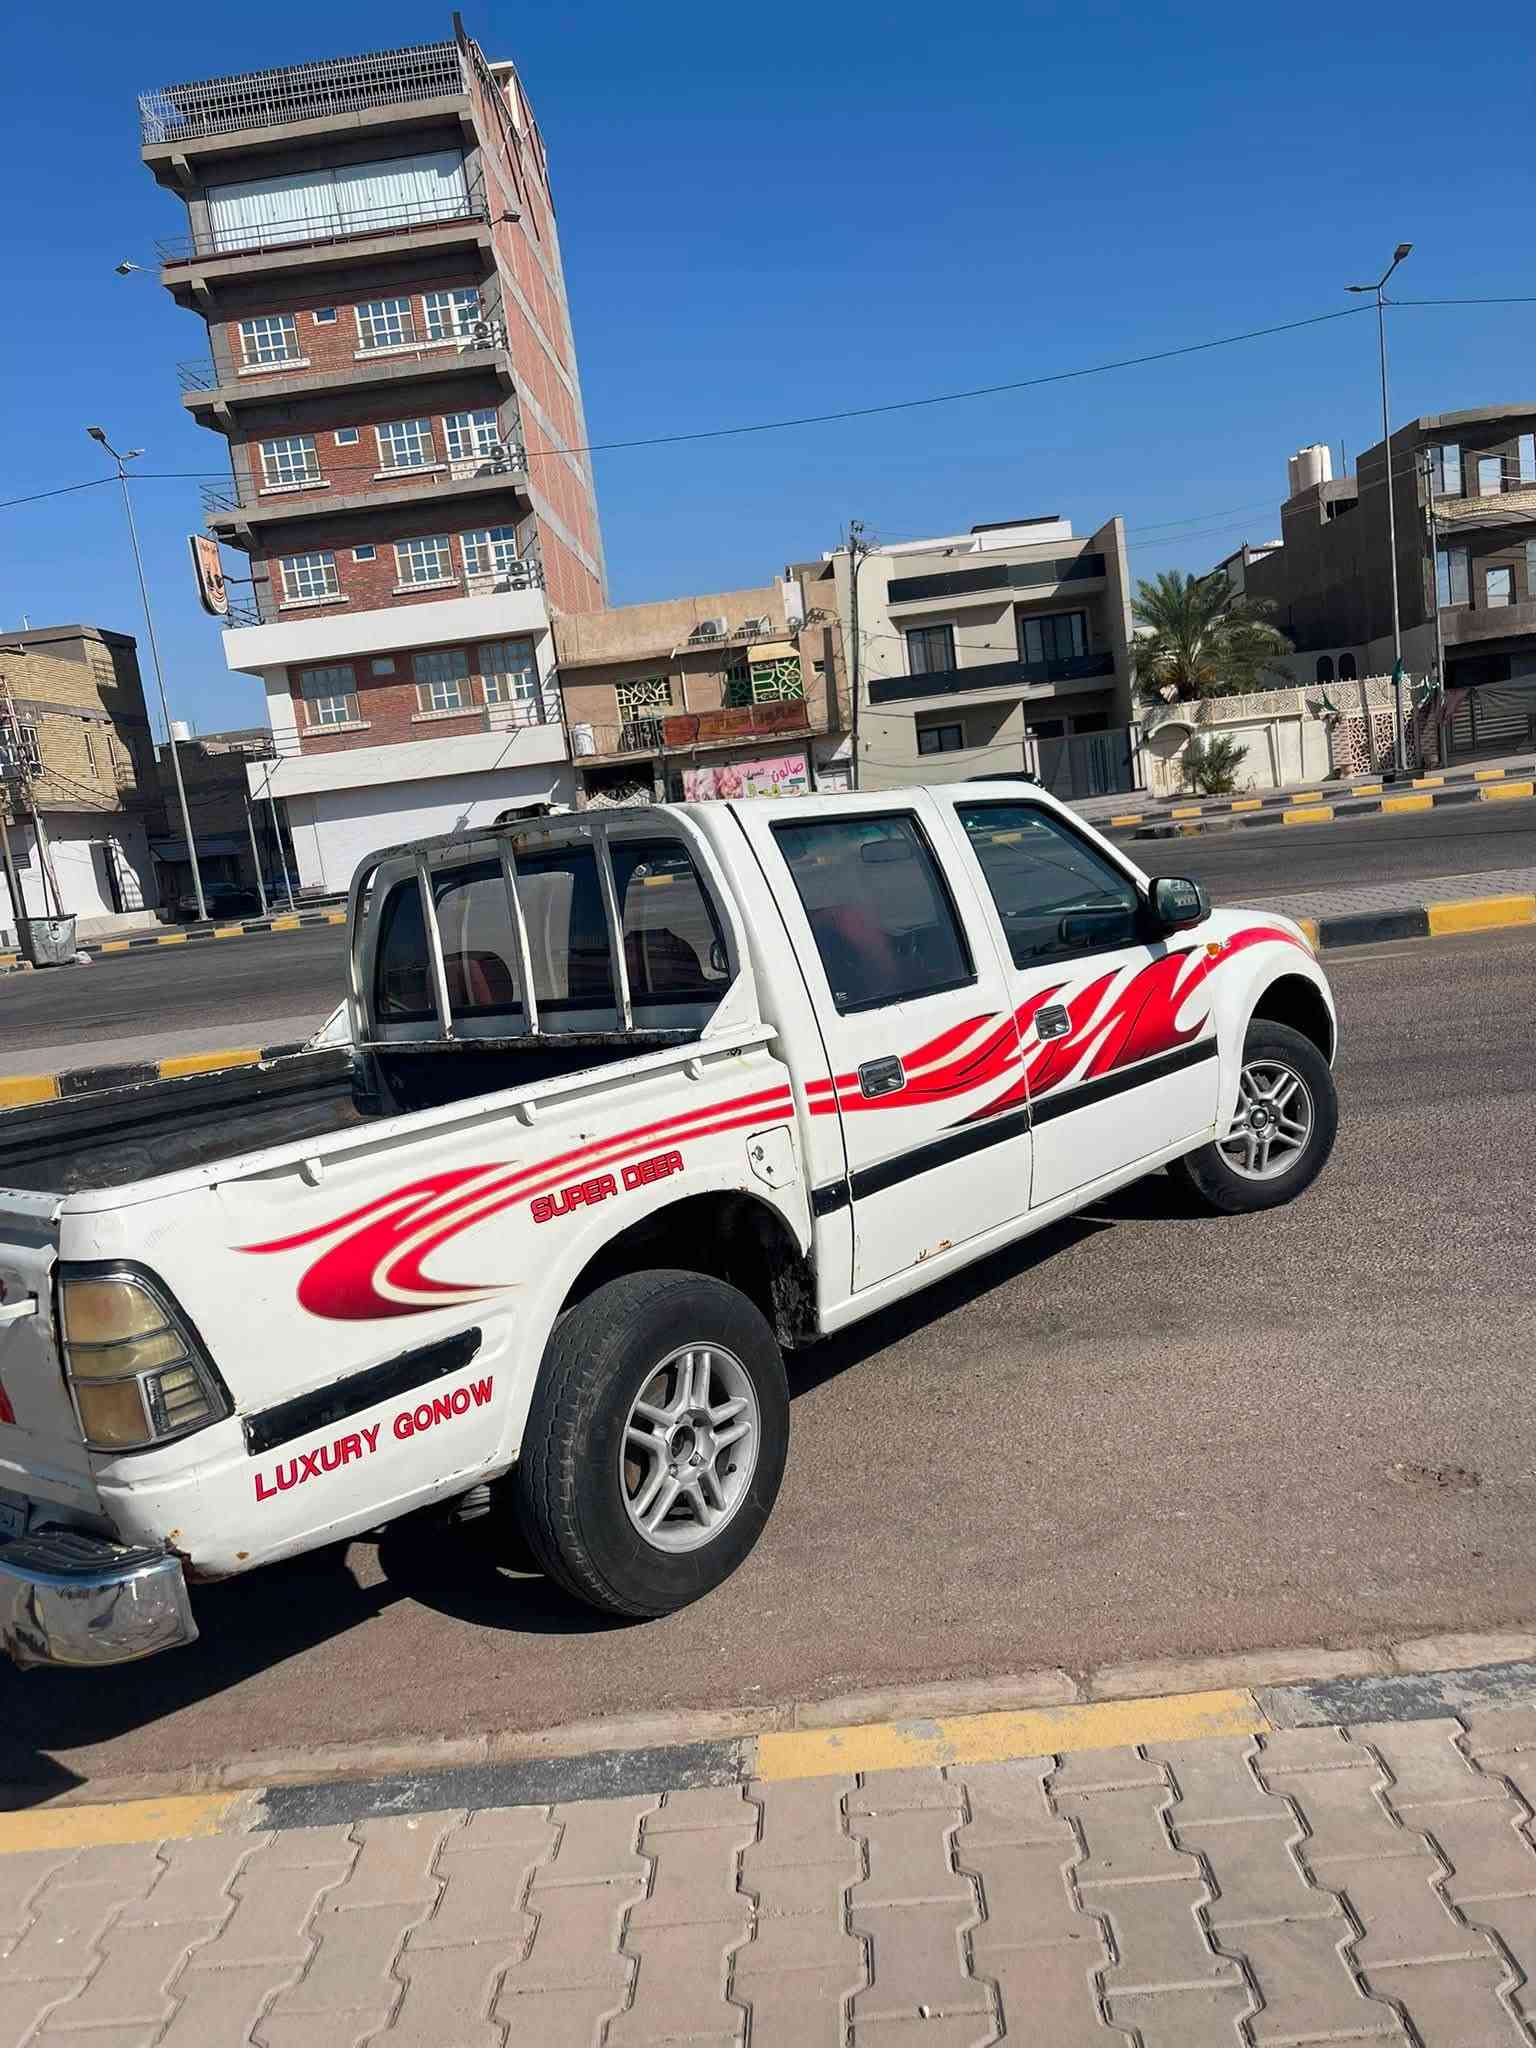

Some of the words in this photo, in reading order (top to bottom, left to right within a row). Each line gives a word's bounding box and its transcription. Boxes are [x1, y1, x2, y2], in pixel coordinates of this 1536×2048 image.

[771, 760, 804, 783] صالون
[531, 1174, 618, 1223] SUPER
[621, 1151, 685, 1191] DEER
[254, 1424, 380, 1502] LUXURY
[393, 1376, 494, 1440] GONOW
